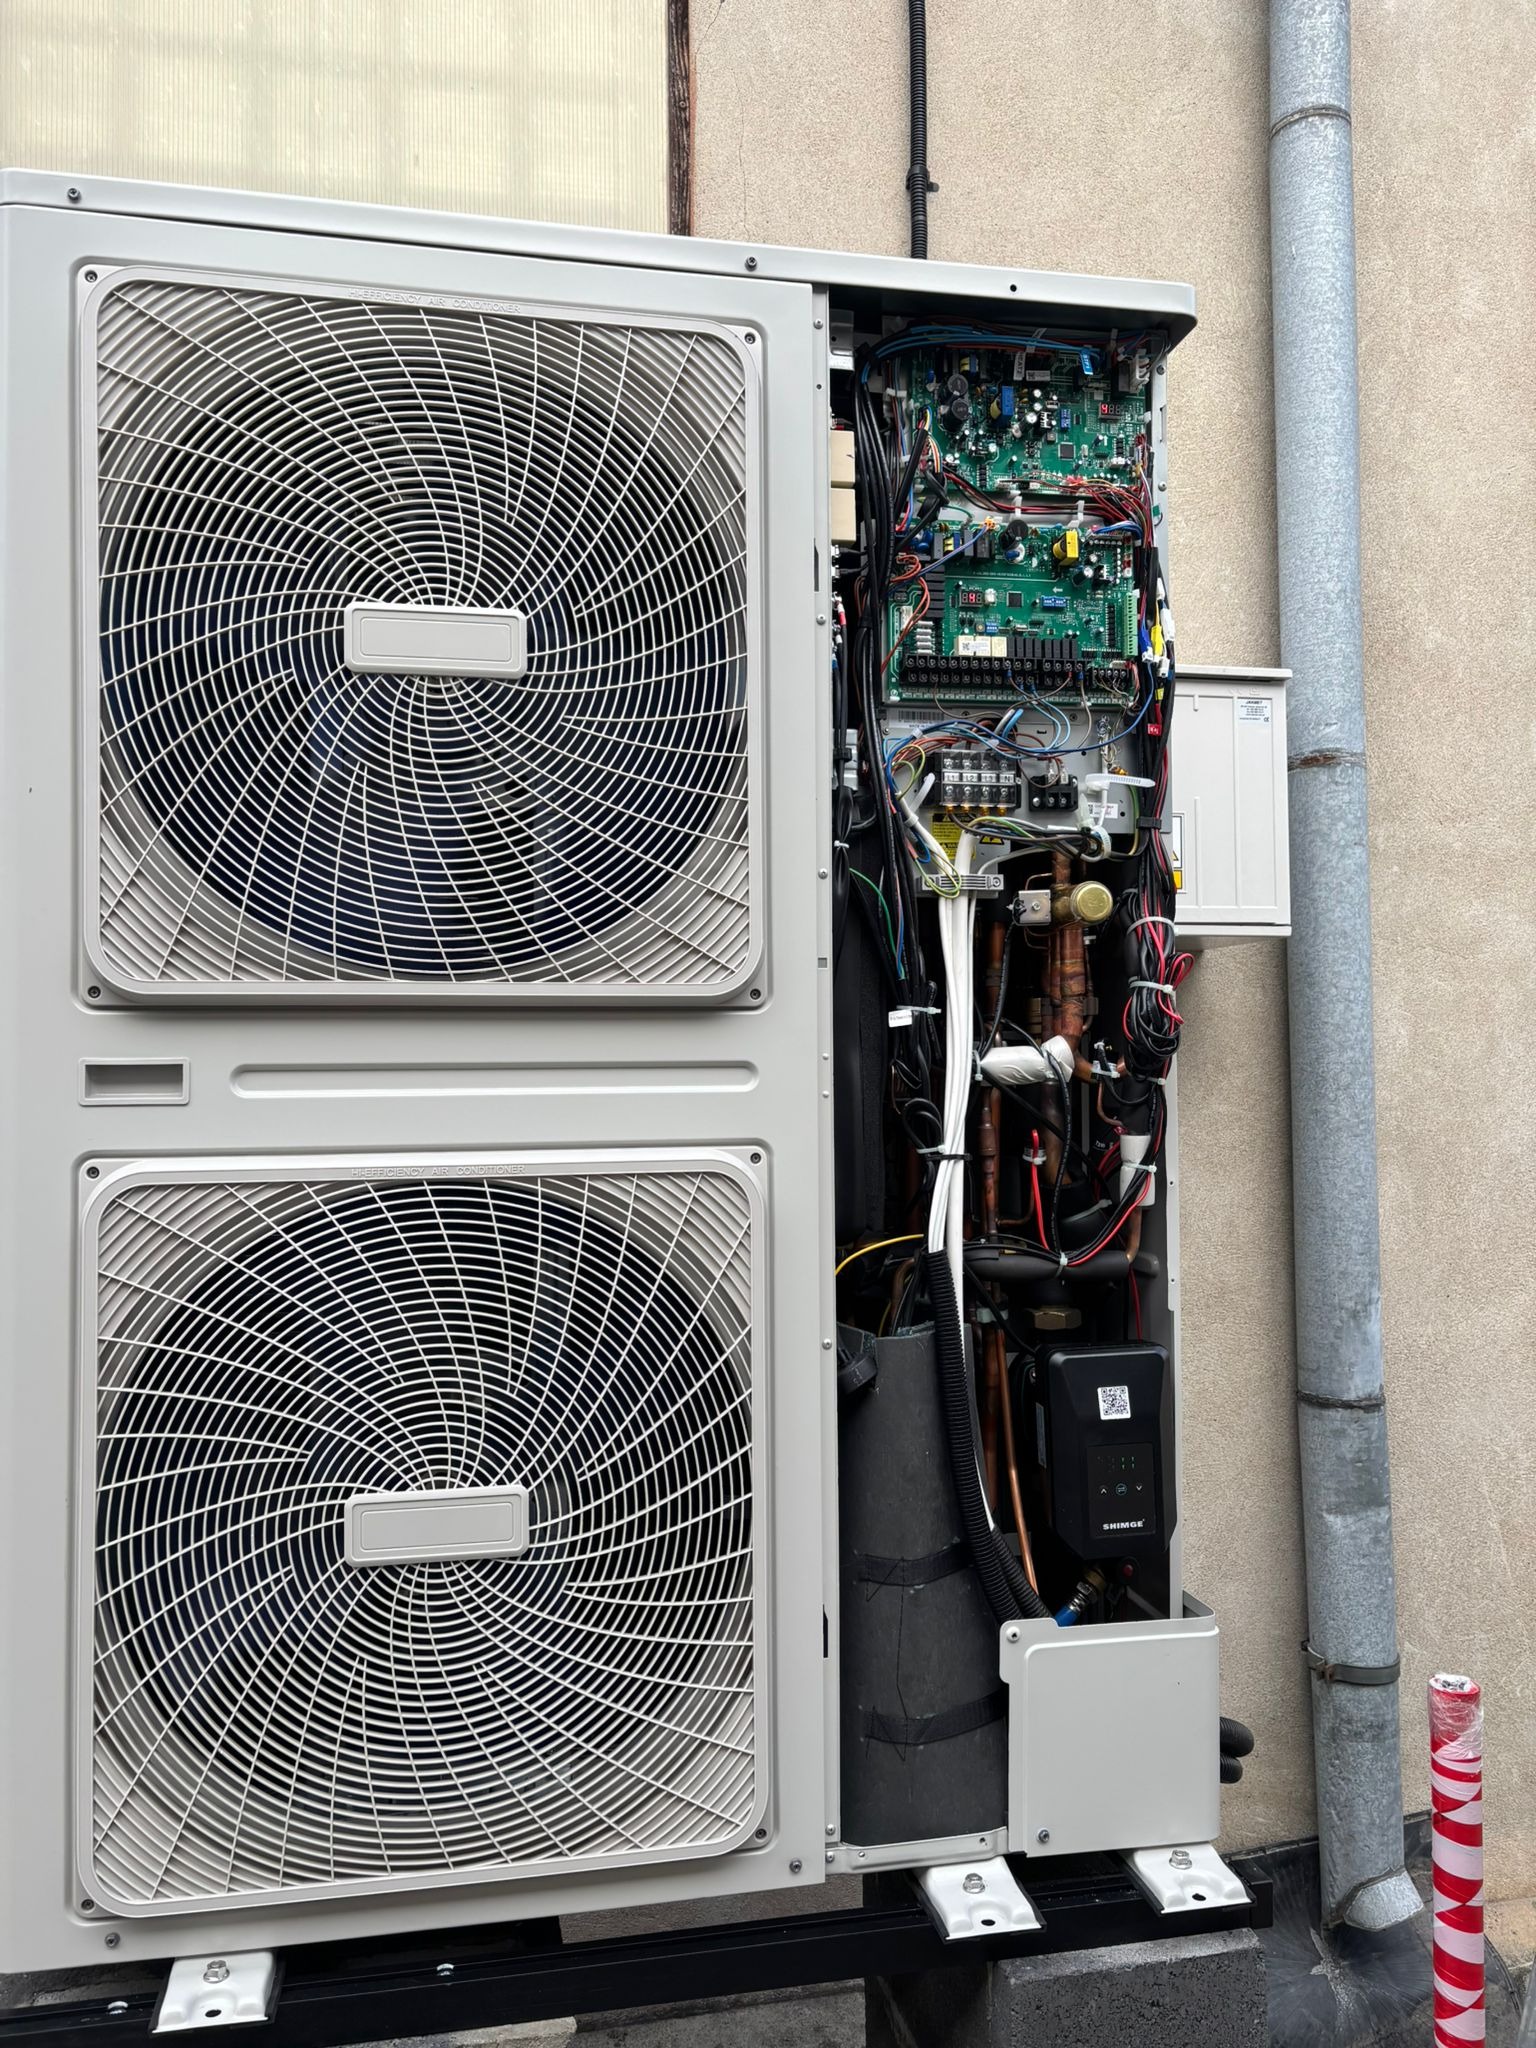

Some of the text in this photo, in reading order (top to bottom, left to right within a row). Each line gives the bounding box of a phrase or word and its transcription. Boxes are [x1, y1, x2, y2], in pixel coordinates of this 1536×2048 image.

[347, 289, 521, 313] HI-EFFICIENCY AIR CONDITIONER
[351, 1165, 526, 1178] HI-EFFICIENCY AIR CONDITIONER
[1102, 1520, 1144, 1531] SHIMGE
